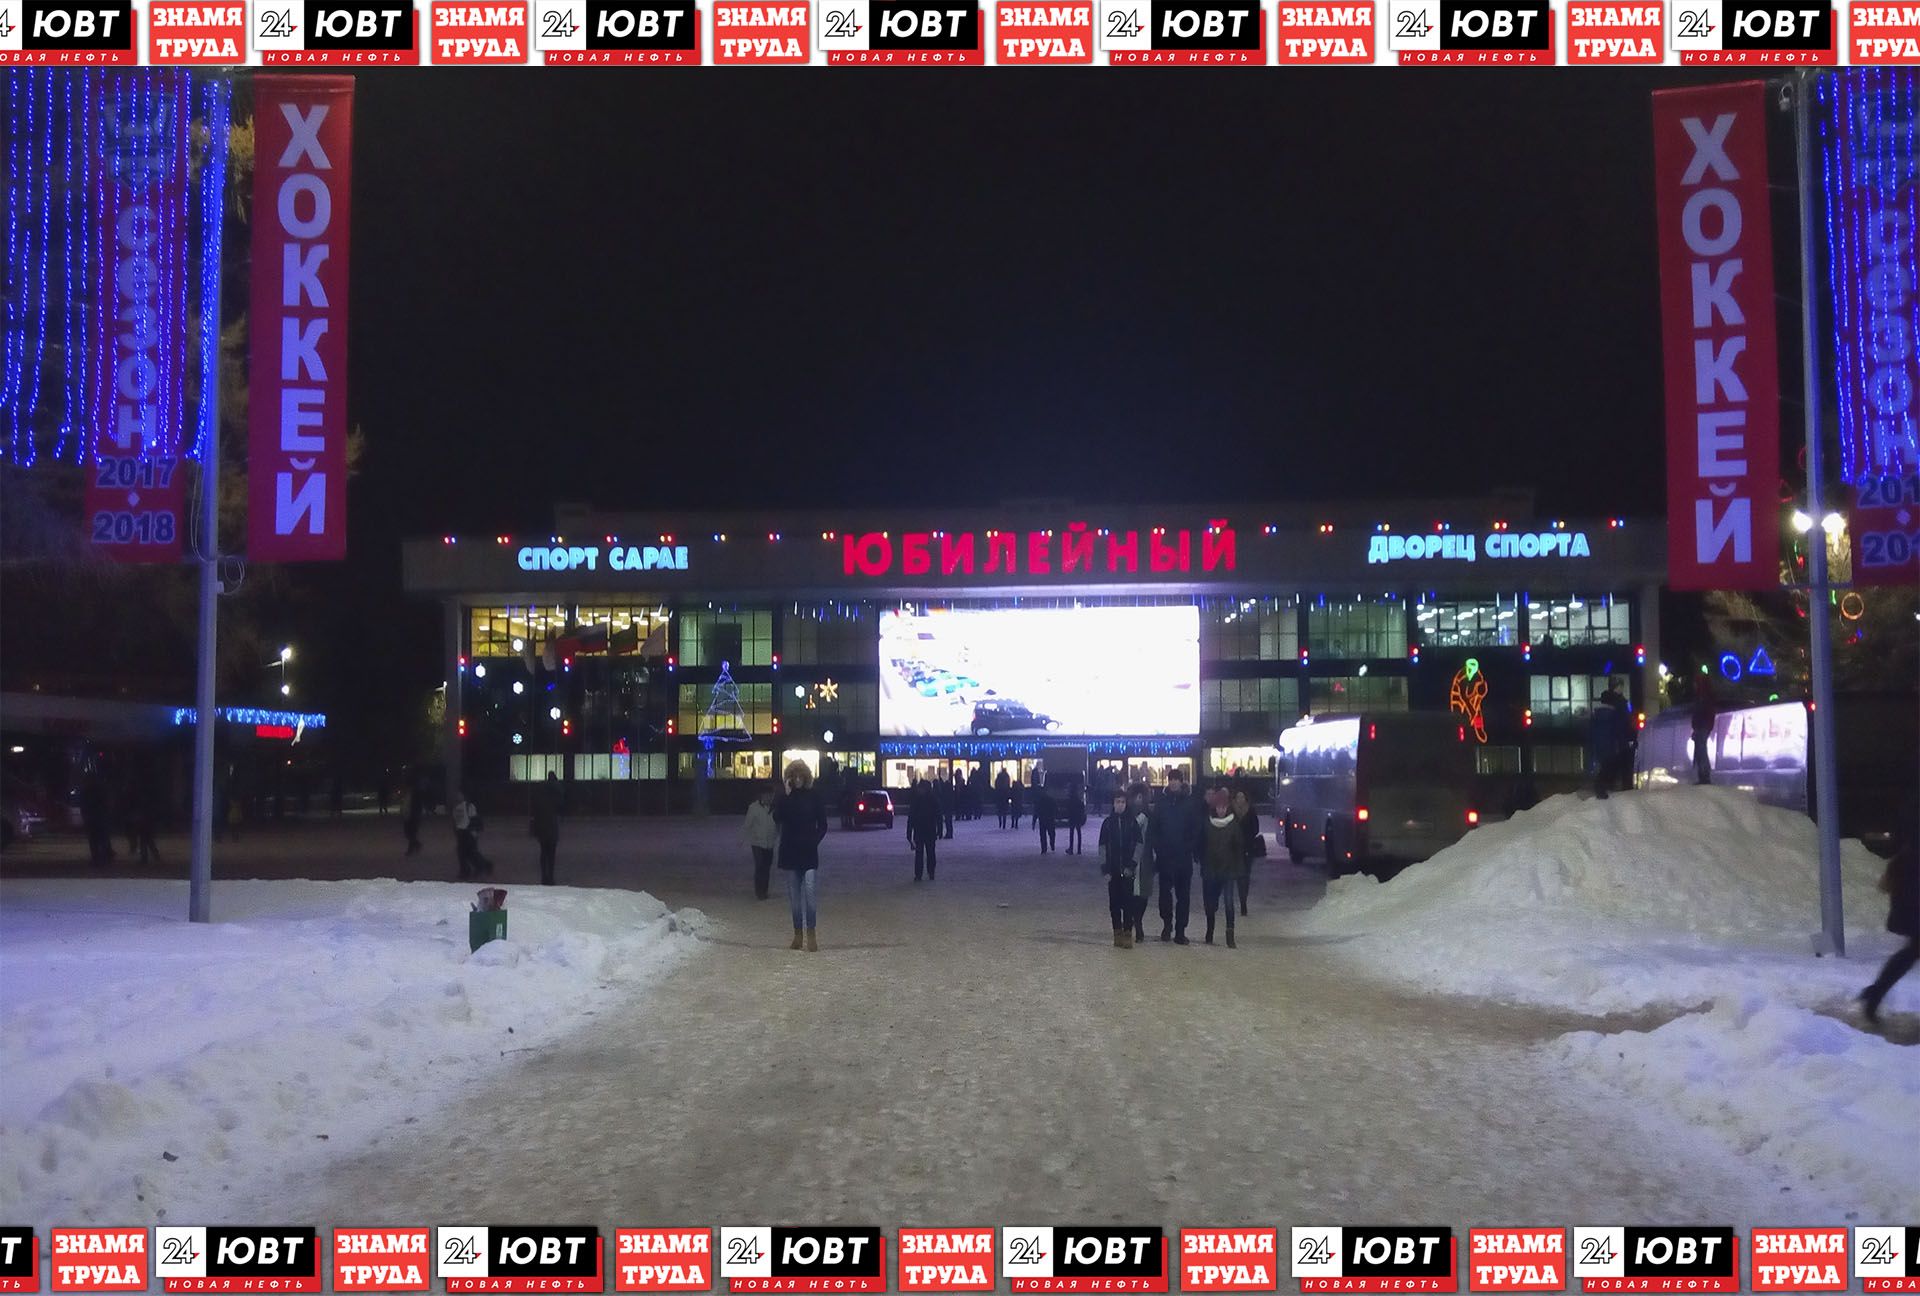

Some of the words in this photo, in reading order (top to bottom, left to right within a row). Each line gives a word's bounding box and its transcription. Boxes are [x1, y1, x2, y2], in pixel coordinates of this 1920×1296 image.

[276, 103, 332, 535] ХОККЕЙ
[1679, 112, 1753, 564] ХОККЕЙ
[95, 456, 177, 488] 2017
[1857, 473, 1920, 508] 201
[91, 511, 175, 545] 2018
[517, 546, 599, 571] СПОРТ
[608, 546, 689, 570] САРАЕ
[842, 518, 1237, 576] ЮБИЛЕЙНЫЙ
[1367, 533, 1476, 564] ДВОРЕЦ
[1485, 531, 1591, 558] СПОРТА
